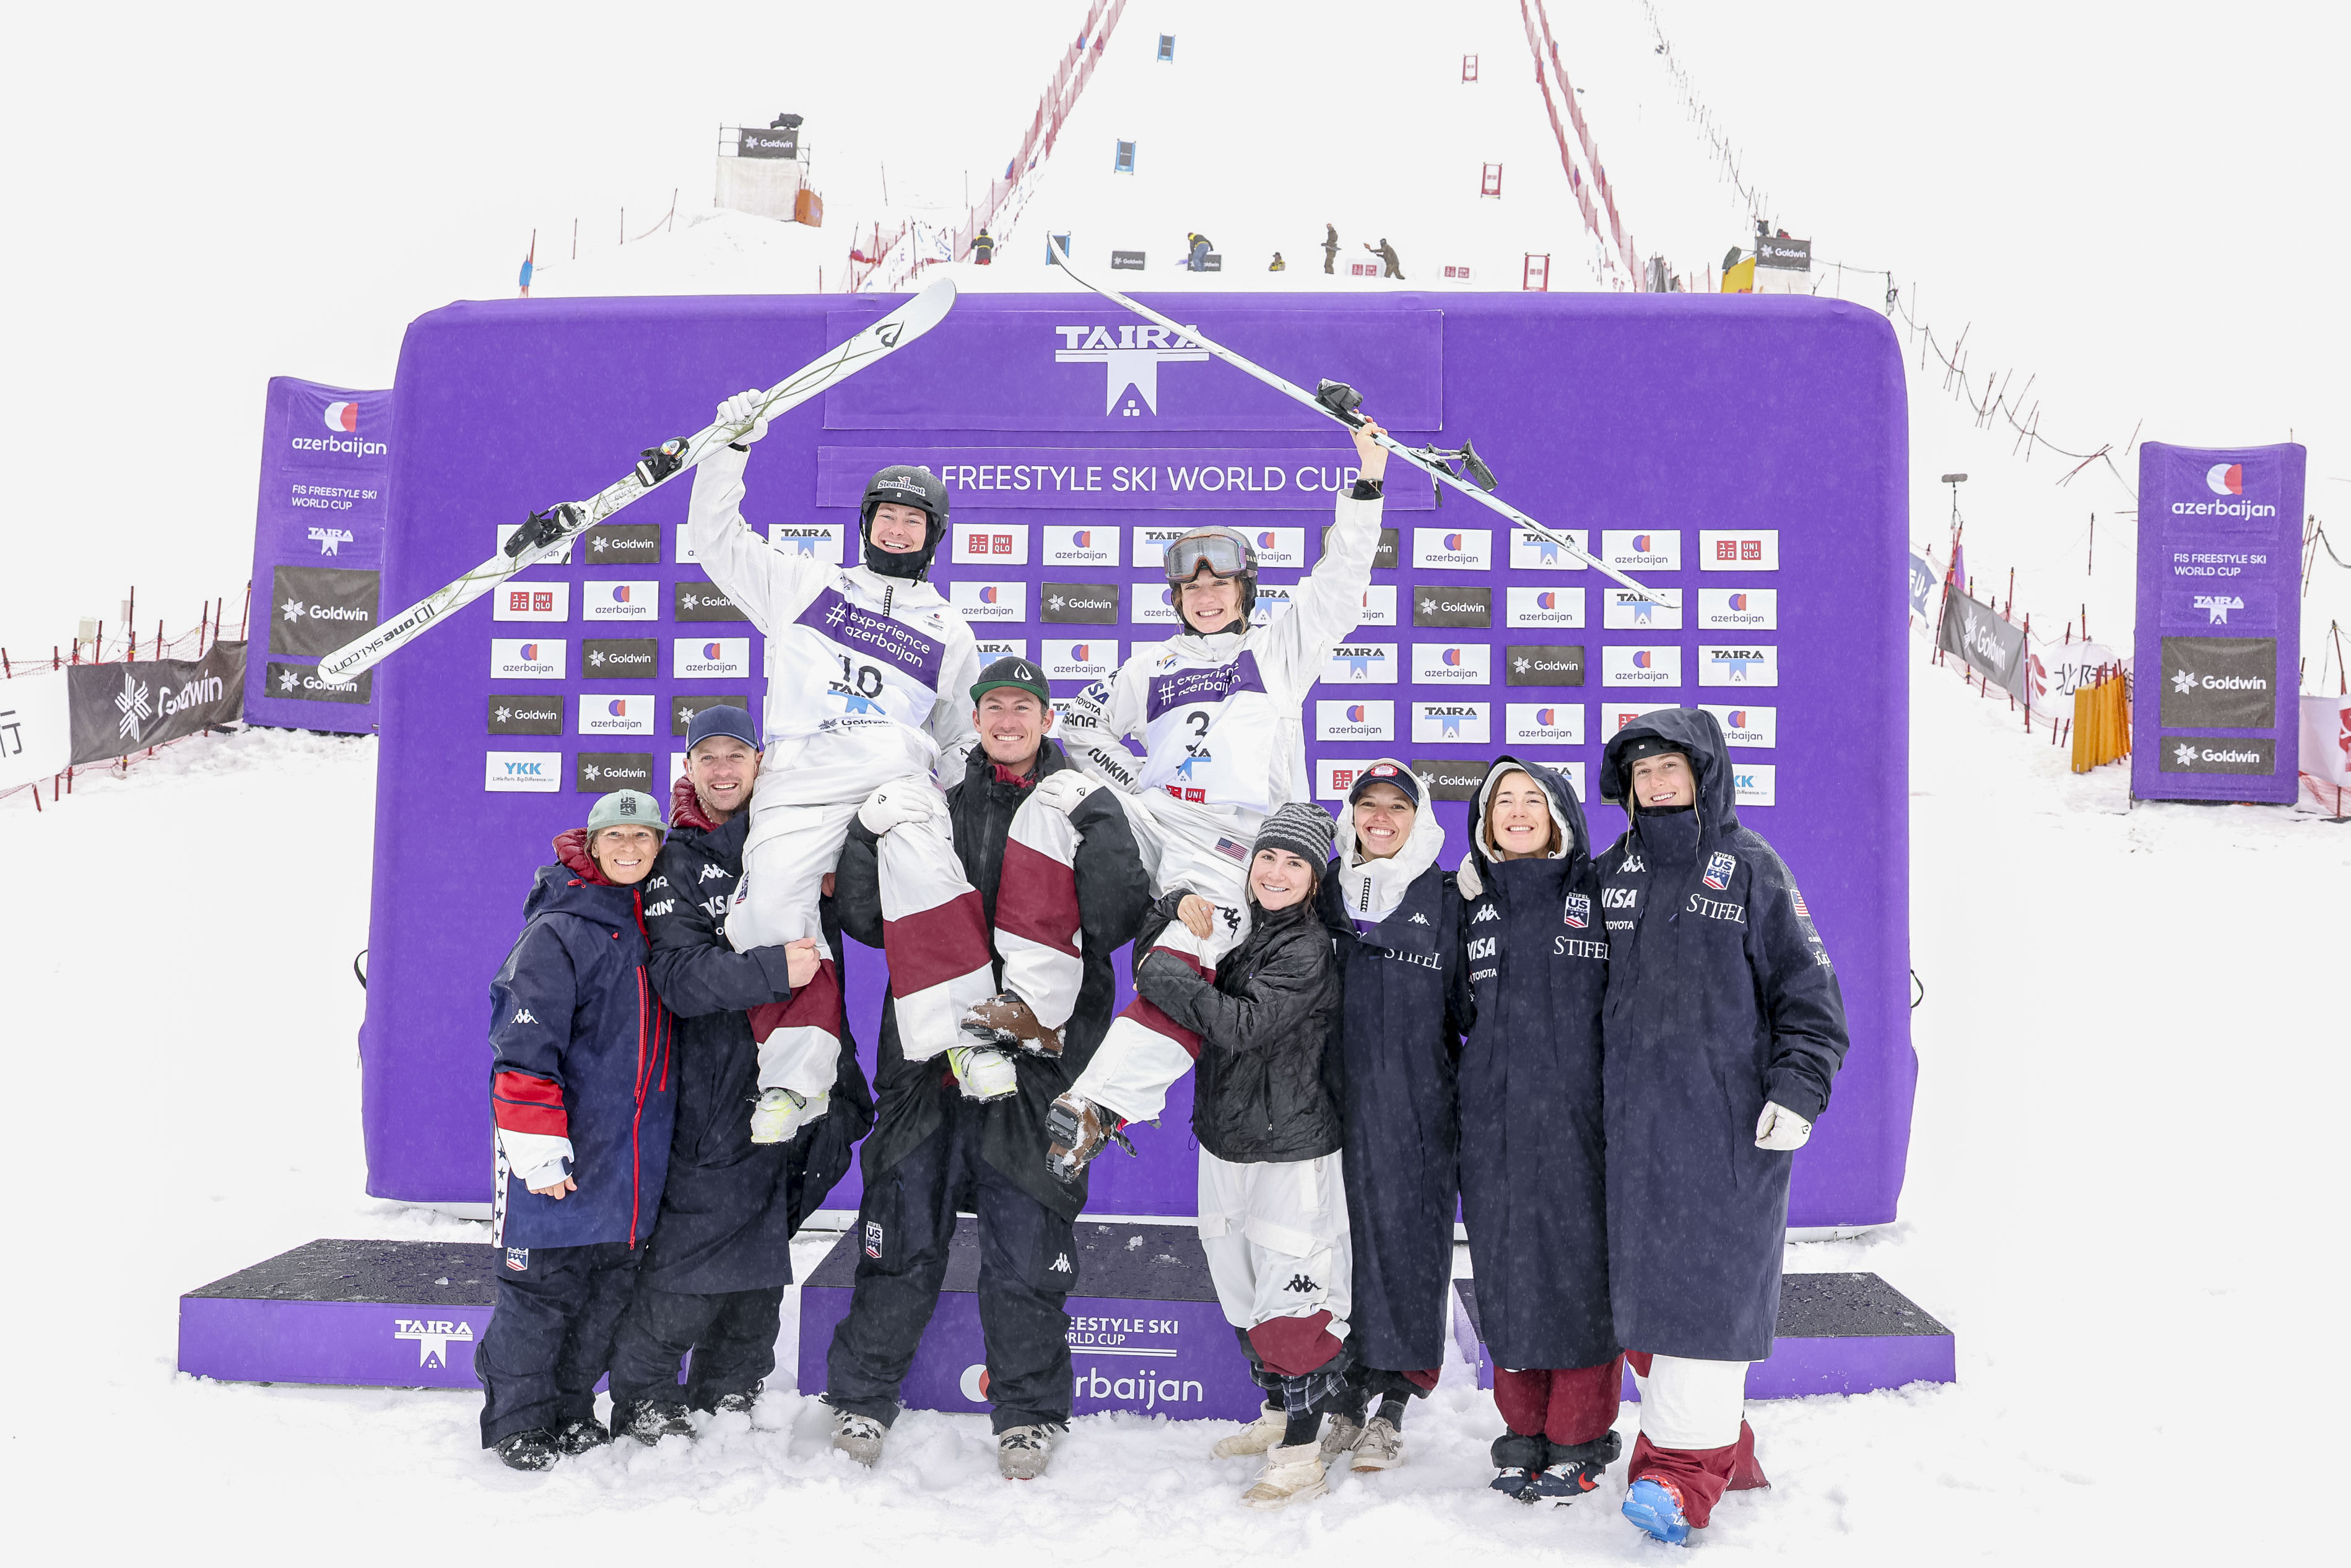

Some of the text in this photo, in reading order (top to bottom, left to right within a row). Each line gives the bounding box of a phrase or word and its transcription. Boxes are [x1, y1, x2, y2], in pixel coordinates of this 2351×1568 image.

[760, 139, 793, 147] Goldwin
[1775, 248, 1806, 258] Goldwin
[292, 436, 386, 457] azerbaijan
[942, 466, 1360, 492] FREESTYLE SKI WORLD CUP
[292, 485, 377, 500] FIS FREESTYLE SKI
[878, 480, 926, 496] Steamboat
[292, 497, 352, 511] WORLD CUP
[2172, 499, 2275, 521] azerbaijan
[307, 527, 354, 538] TAIRA
[1145, 531, 1183, 540] TAIR
[1523, 532, 1576, 543] TAA
[612, 539, 653, 548] Goldwin
[995, 545, 1009, 553] QLO
[1056, 550, 1106, 561] azerbaijan
[1256, 552, 1291, 562] rbaijan
[1426, 553, 1478, 564] azerbaijan
[1615, 555, 1667, 565] azerbaijan
[1744, 551, 1758, 559] QLO
[2175, 553, 2266, 563] FIS FREESTYLE SKI
[2175, 566, 2241, 576] WORLD CUP
[1256, 591, 1290, 599] IRA
[2193, 596, 2244, 605] TAIRA
[702, 597, 733, 607] Goldw
[1069, 599, 1111, 609] Goldwin
[1441, 602, 1484, 612] Goldwin
[310, 605, 368, 621] Goldwin
[596, 605, 646, 615] azerbaijan
[962, 607, 1013, 617] azerbaijan
[1144, 607, 1179, 617] azerba
[1362, 610, 1384, 620] aijan
[1520, 612, 1572, 623] azerbaijan
[1711, 614, 1764, 624] azerbaijan
[845, 625, 923, 669] azerbaijan
[1977, 625, 2007, 671] Goldwin
[609, 654, 651, 663] Goldwin
[1711, 651, 1763, 659] TAIRA
[503, 664, 553, 674] azerbaijan
[686, 662, 737, 673] azerbaijan
[1054, 664, 1105, 675] azerbaijan
[1534, 661, 1578, 670] Goldwin
[838, 653, 884, 699] 10
[1425, 669, 1477, 679] azerbaijan
[1615, 671, 1668, 682] azerbaijan
[2202, 675, 2266, 689] Goldwin
[1087, 683, 1110, 705] SA
[1075, 696, 1101, 716] TOYOTA
[515, 710, 556, 719] Goldwin
[591, 719, 641, 730] azerbaijan
[1186, 711, 1210, 753] 3
[1329, 726, 1381, 735] azerbaijan
[1519, 729, 1571, 739] azerbaijan
[1723, 731, 1762, 742] erbaijan
[2202, 749, 2259, 763] Goldwin
[503, 761, 542, 775] YKK
[604, 768, 645, 778] Goldwin
[1439, 775, 1483, 787] Goldwin
[1734, 775, 1754, 787] KK
[1188, 791, 1202, 799] UNI
[1714, 851, 1736, 861] STIFEL
[1712, 857, 1732, 871] US
[645, 875, 669, 896] ANA
[1568, 898, 1588, 909] US
[1602, 888, 1638, 909] VISA
[644, 898, 675, 919] KIN'
[1686, 893, 1745, 924] STIFEL
[1606, 920, 1634, 930] TOYOTA
[1467, 937, 1496, 961] VISA
[1554, 936, 1610, 960] STIFEL
[1472, 968, 1497, 981] TOYOTA
[867, 1227, 880, 1239] US
[394, 1319, 474, 1335] TAIRA
[1069, 1316, 1178, 1335] EESTYLE SKI
[1069, 1332, 1126, 1346] RLD CUP
[1076, 1367, 1204, 1410] rbaijan
